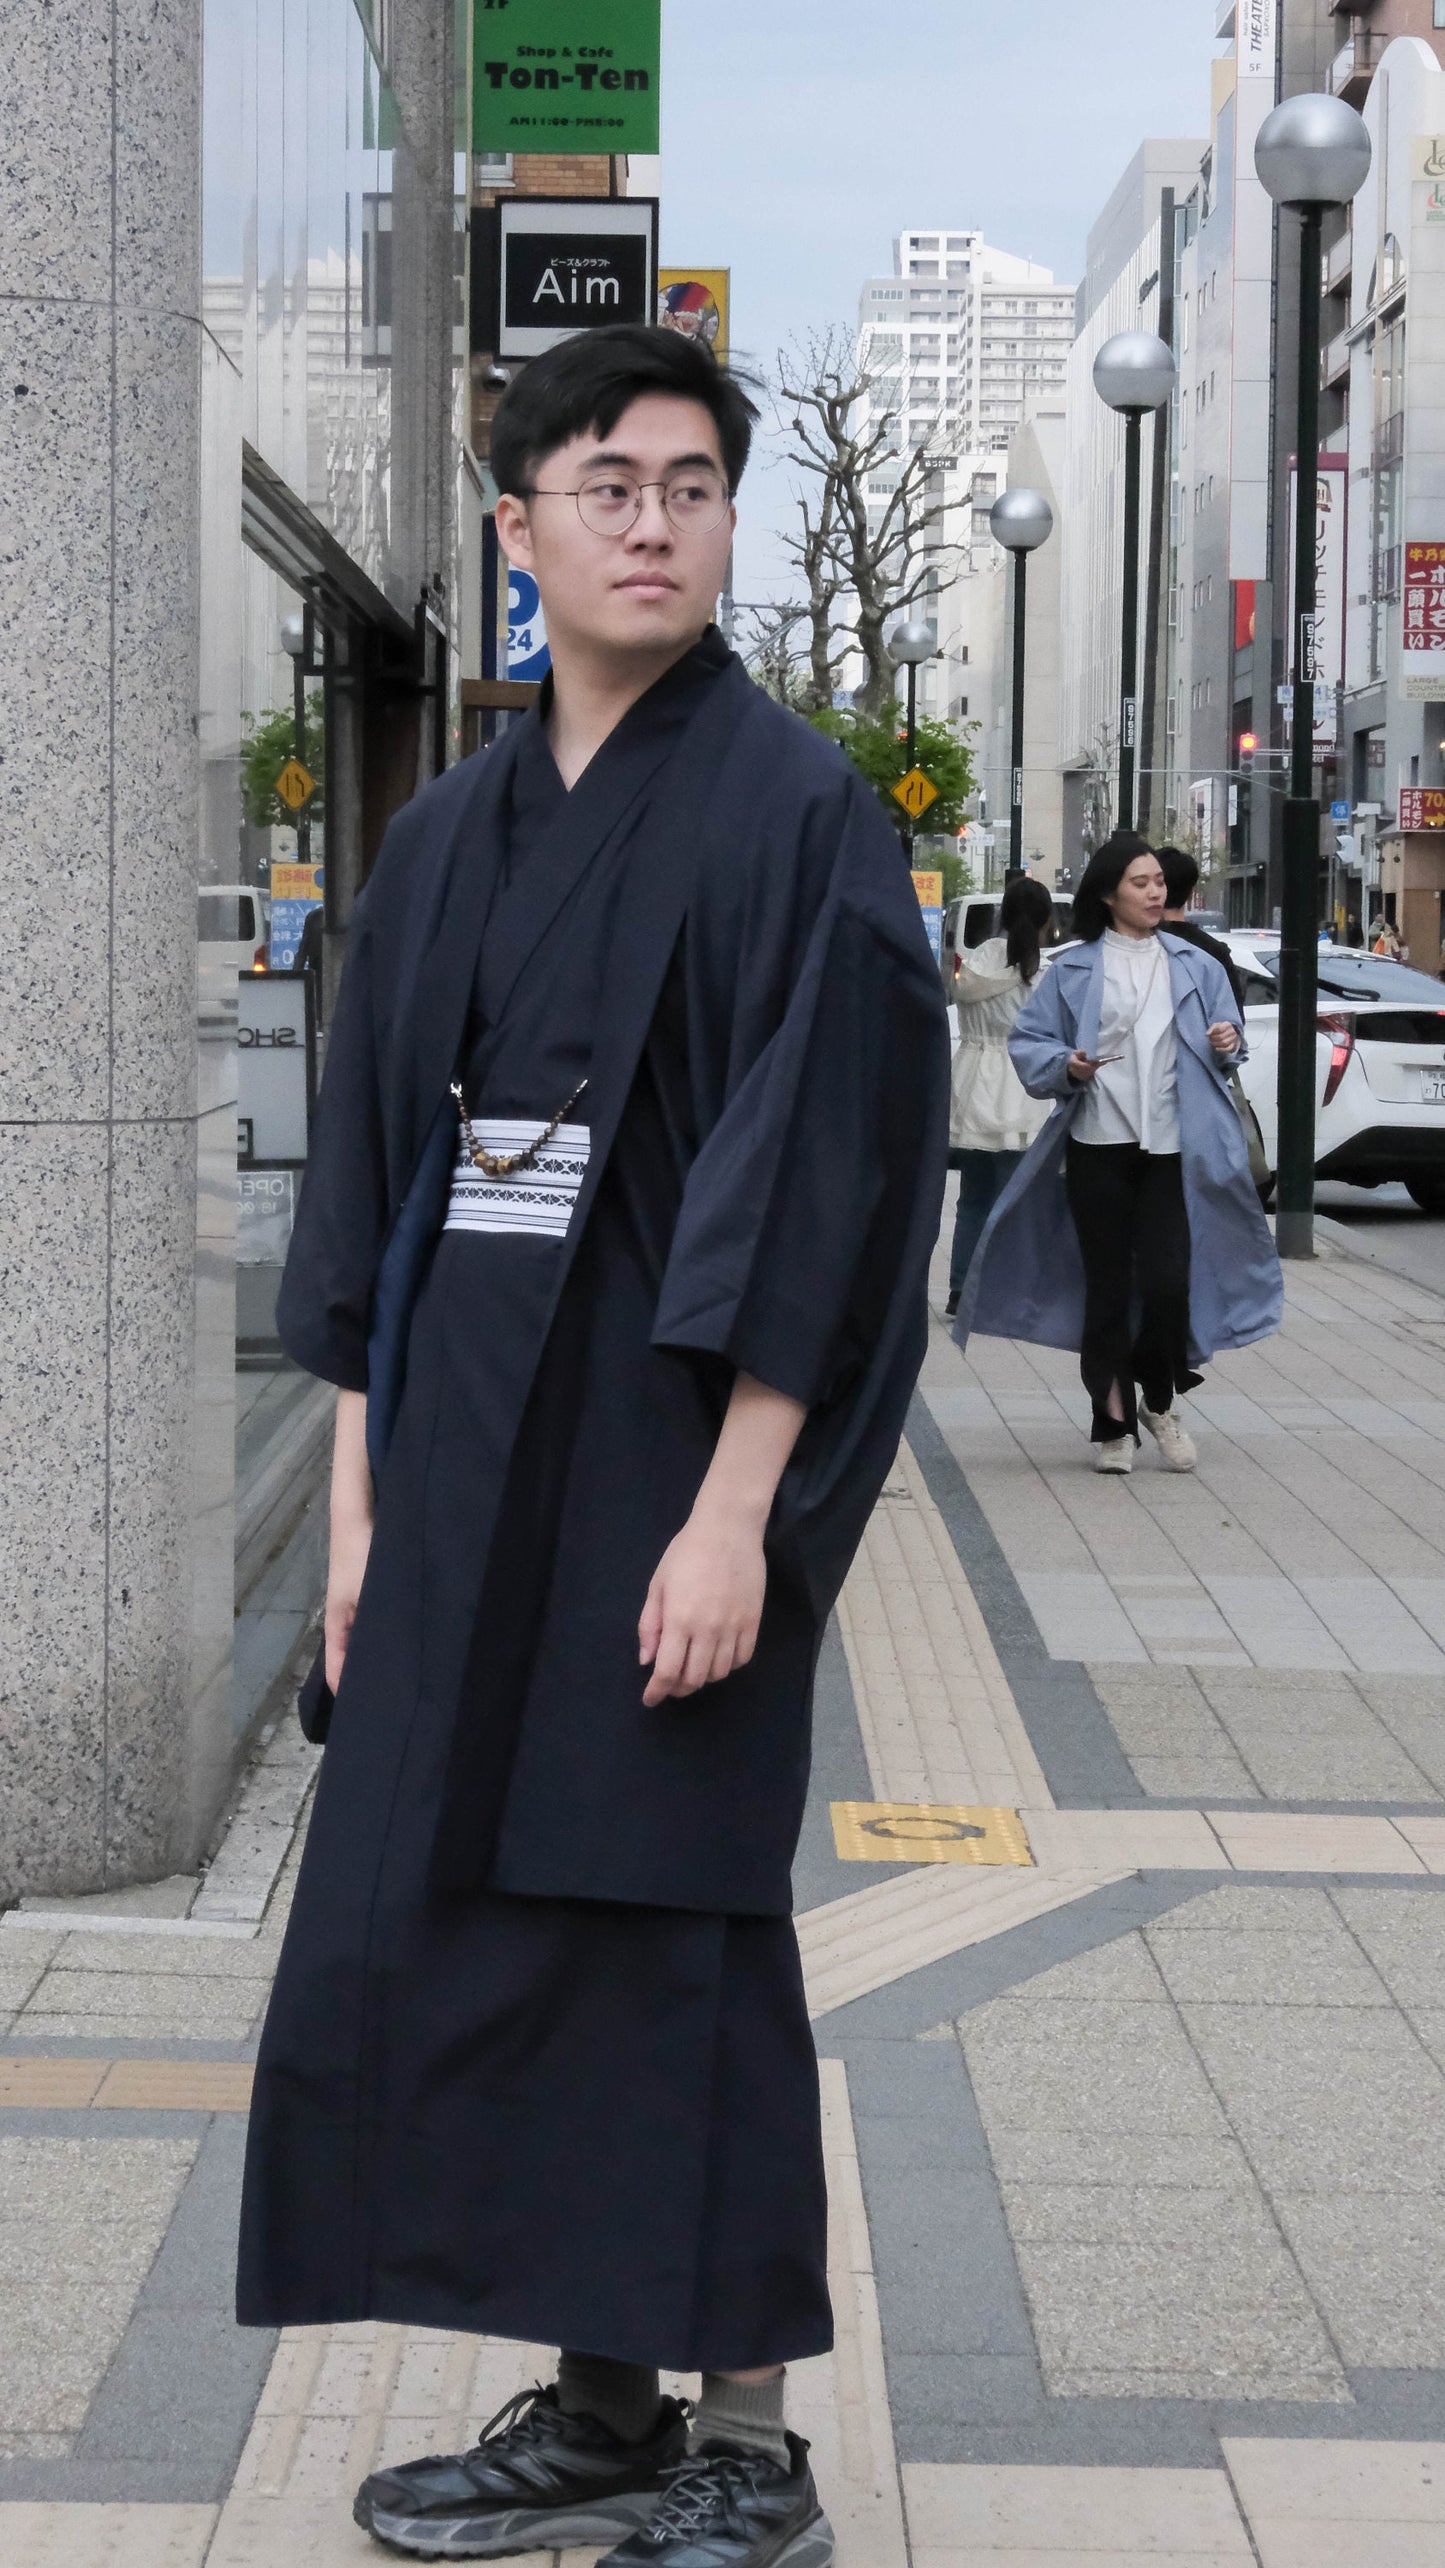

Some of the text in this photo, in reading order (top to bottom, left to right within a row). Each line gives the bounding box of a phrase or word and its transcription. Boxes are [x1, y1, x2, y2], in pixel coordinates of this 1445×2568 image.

[516, 46, 557, 59] Shop
[561, 46, 573, 57] &
[484, 62, 649, 91] Ton-Ten
[551, 258, 611, 267] ビーズ&クラフト
[532, 267, 620, 304] Aim
[1412, 791, 1422, 828] ホルモン
[1424, 791, 1445, 808] 70
